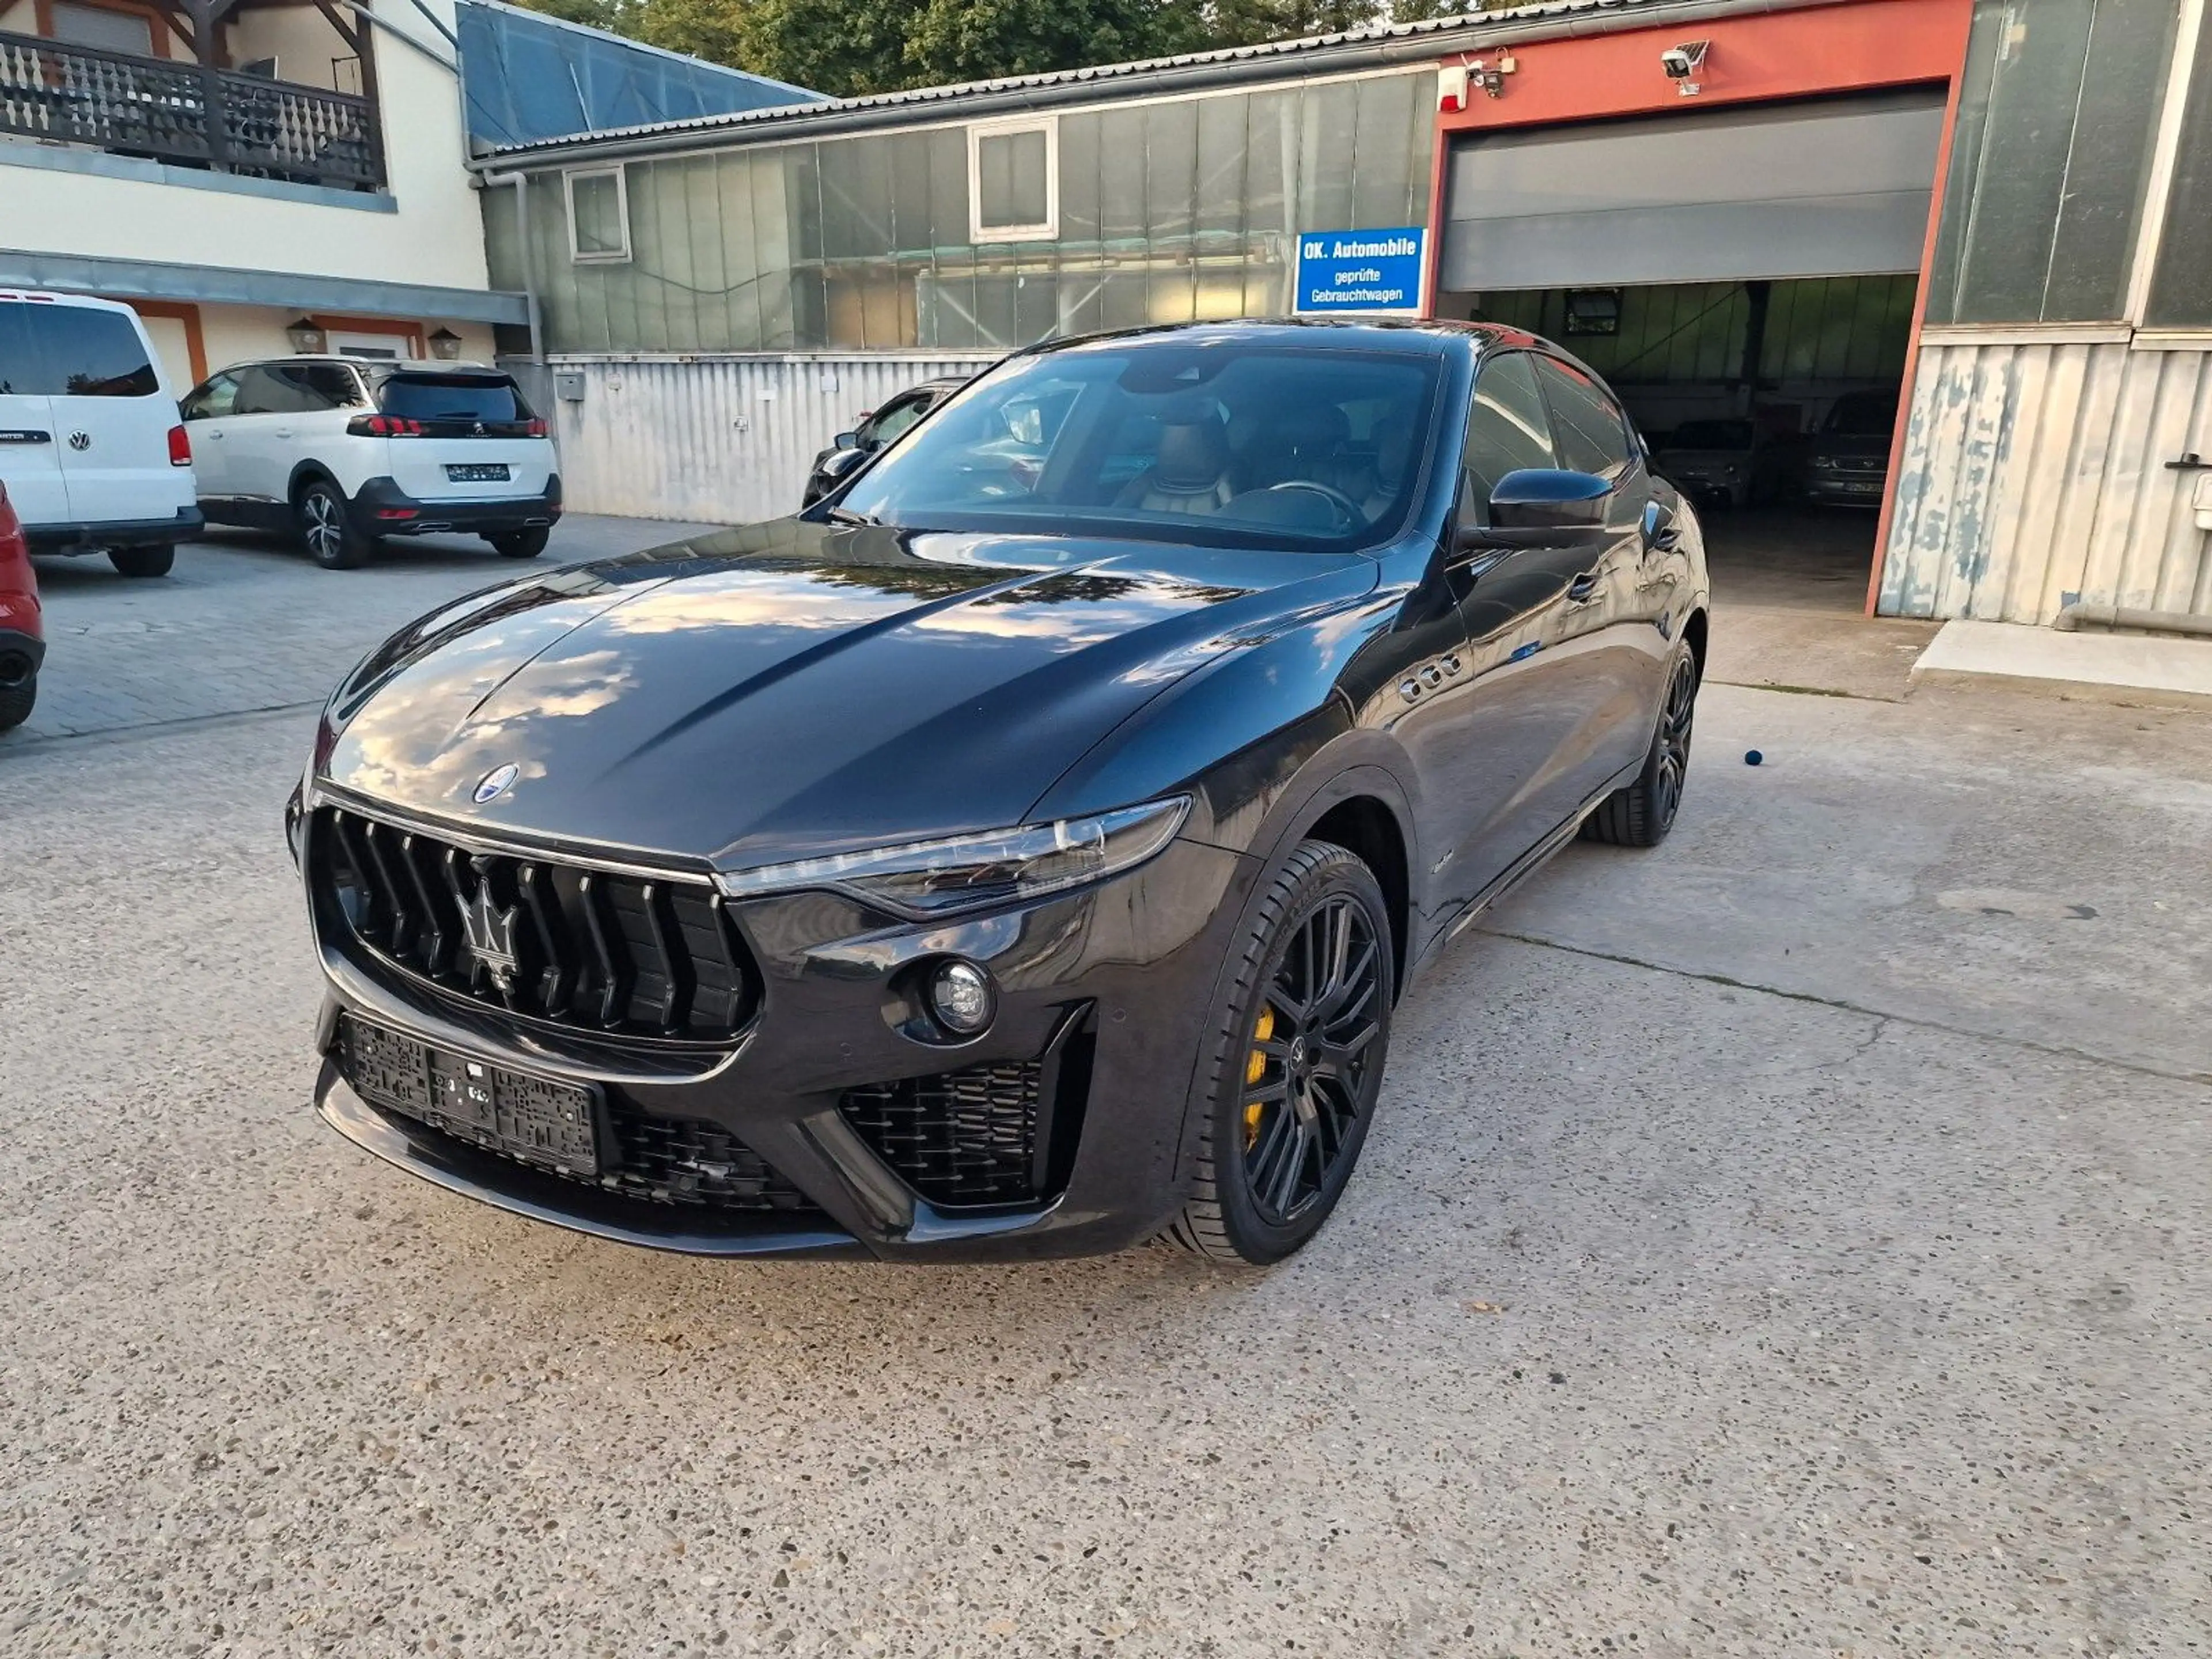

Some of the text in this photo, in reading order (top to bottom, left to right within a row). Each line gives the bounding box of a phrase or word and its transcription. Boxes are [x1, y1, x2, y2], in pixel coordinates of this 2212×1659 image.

[1304, 238, 1416, 259] OK. Automobile
[1335, 268, 1381, 285] geprüfte
[1312, 289, 1403, 304] Gebrauchtwagen
